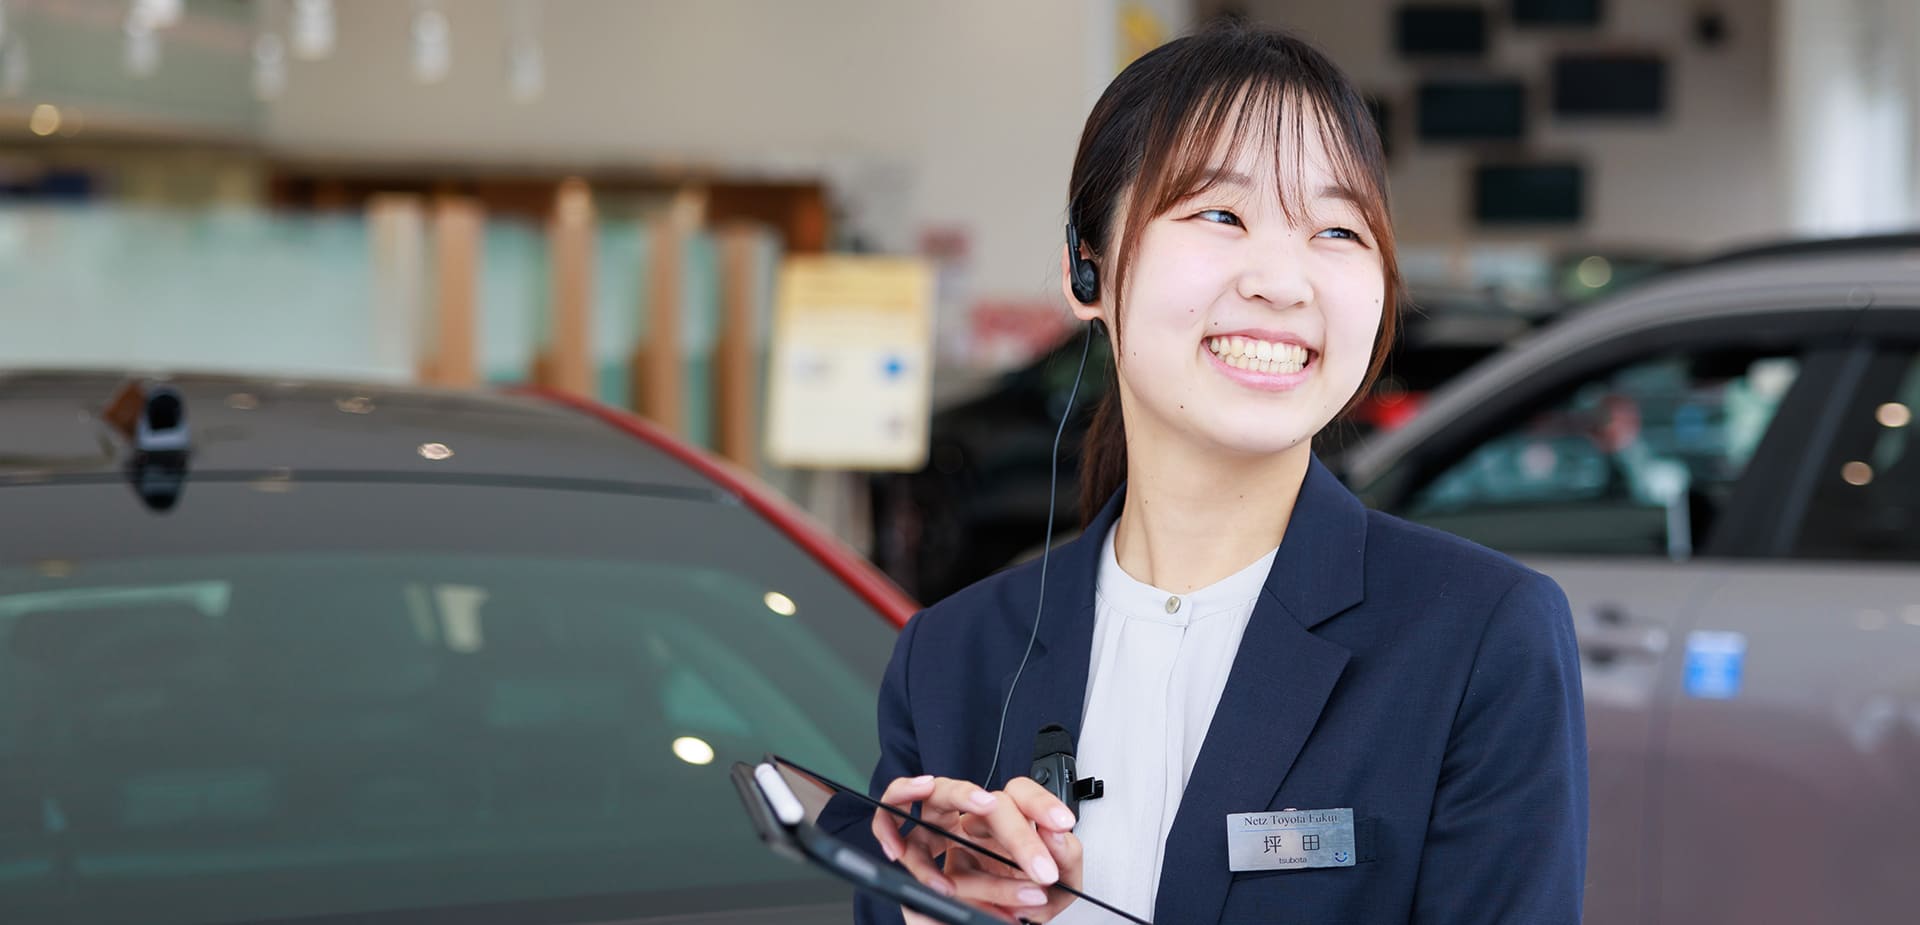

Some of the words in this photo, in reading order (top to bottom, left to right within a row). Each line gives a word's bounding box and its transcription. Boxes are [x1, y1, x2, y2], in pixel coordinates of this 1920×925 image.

[1244, 816, 1268, 826] Netz
[1271, 815, 1306, 827] Toyota
[1263, 834, 1320, 854] 坪田
[1279, 857, 1307, 865] tsubota
